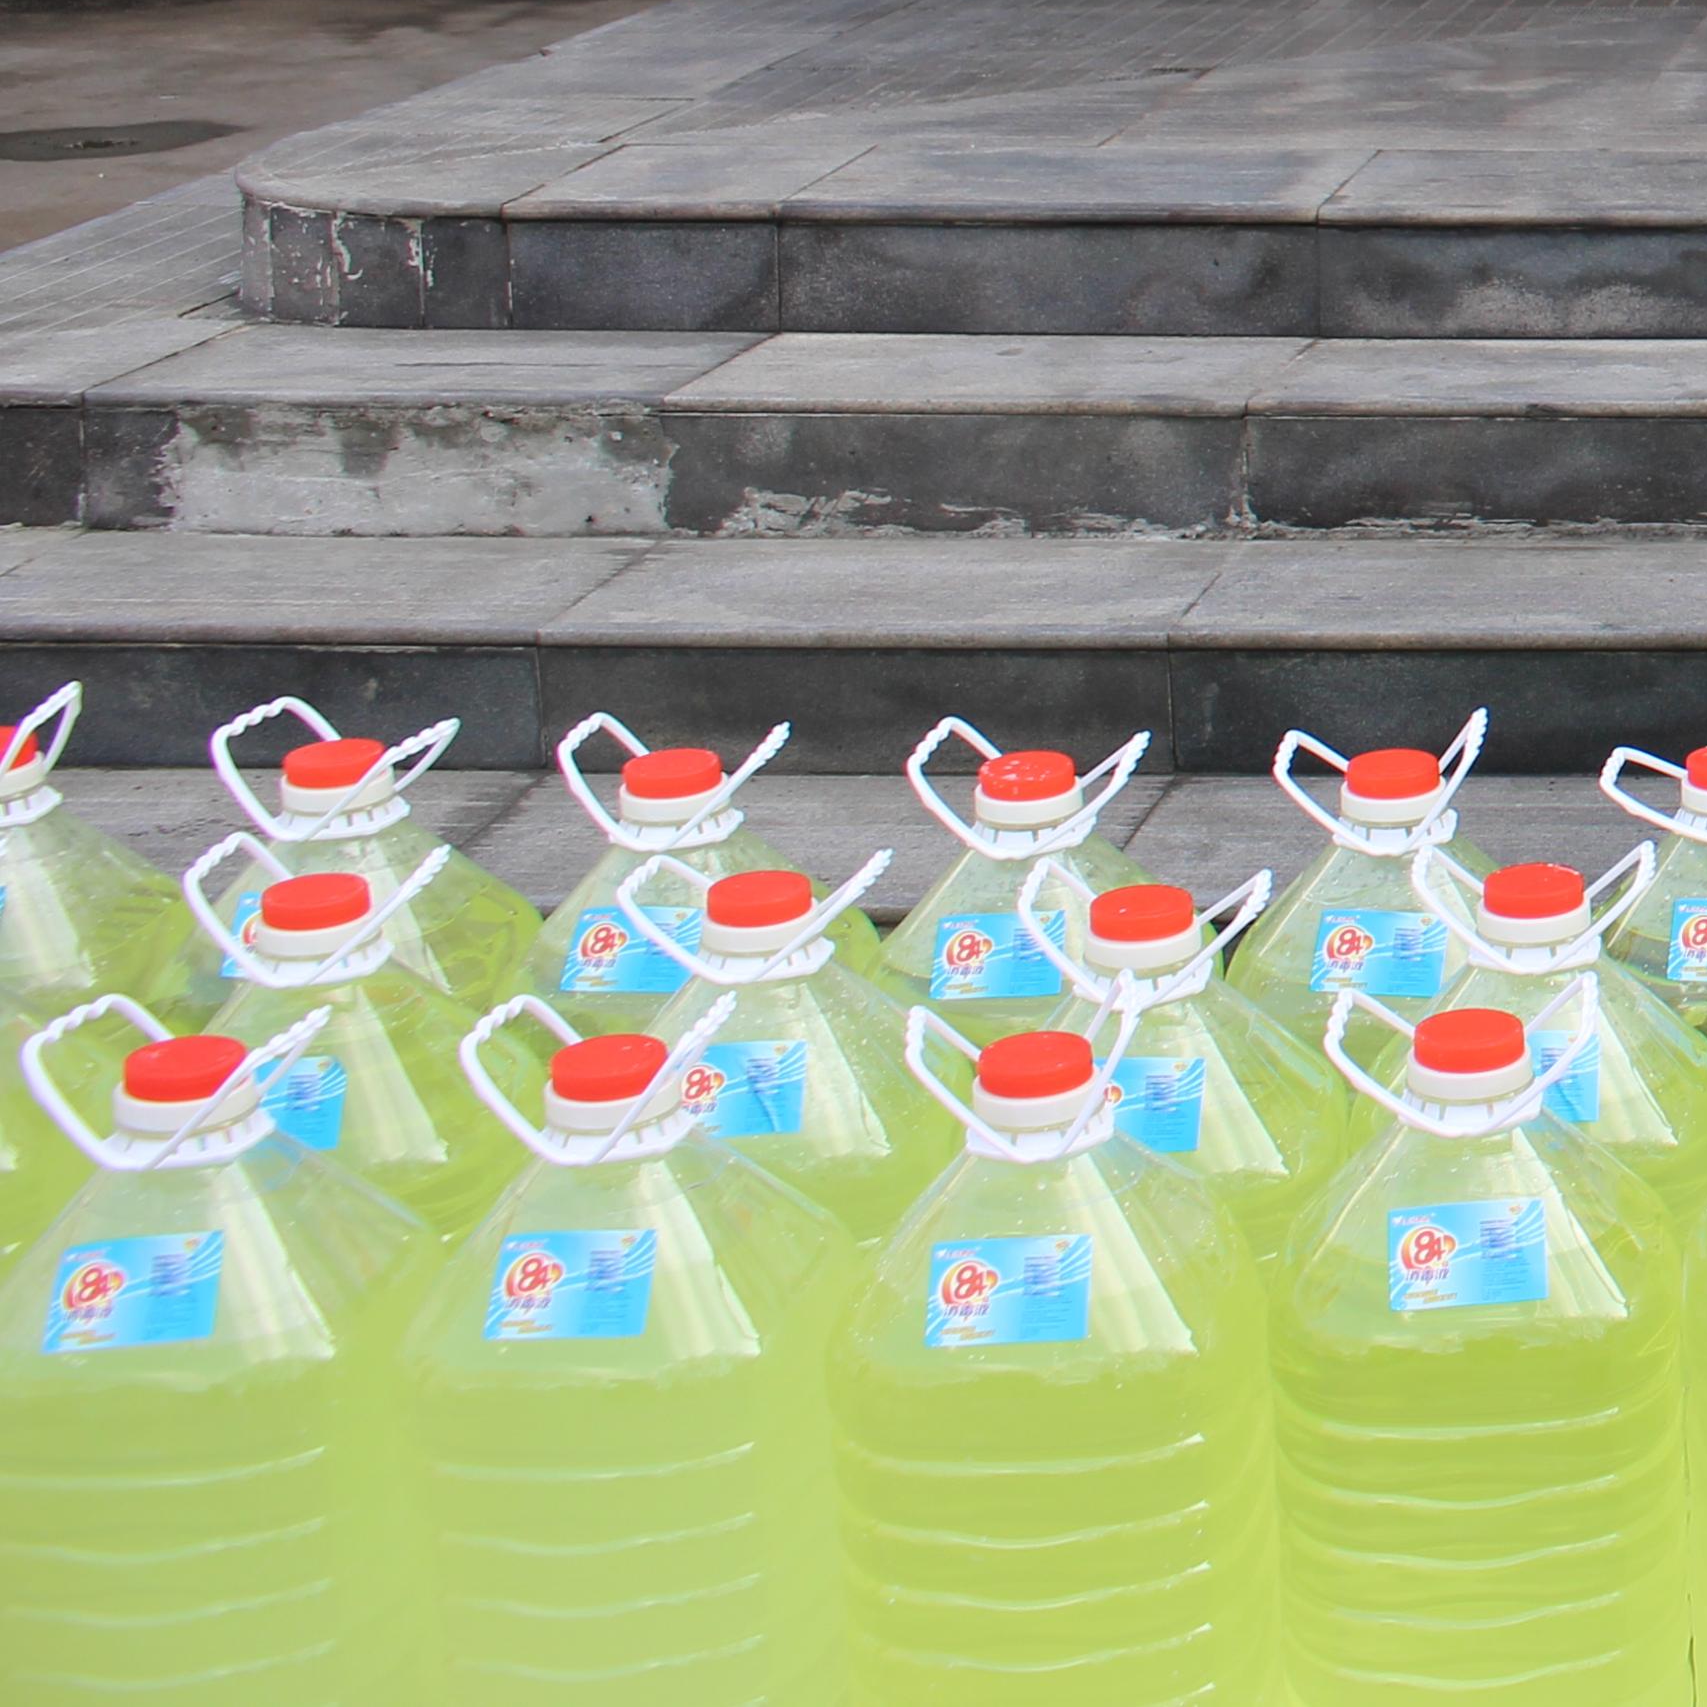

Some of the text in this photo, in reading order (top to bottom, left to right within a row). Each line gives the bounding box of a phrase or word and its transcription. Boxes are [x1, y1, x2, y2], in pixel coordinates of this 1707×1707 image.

[590, 926, 618, 955] 84
[956, 933, 982, 963] 84
[1336, 928, 1364, 956] 84
[683, 1070, 714, 1102] 84
[1413, 1229, 1446, 1267] 84
[517, 1256, 551, 1293] 84
[953, 1264, 987, 1300] 84
